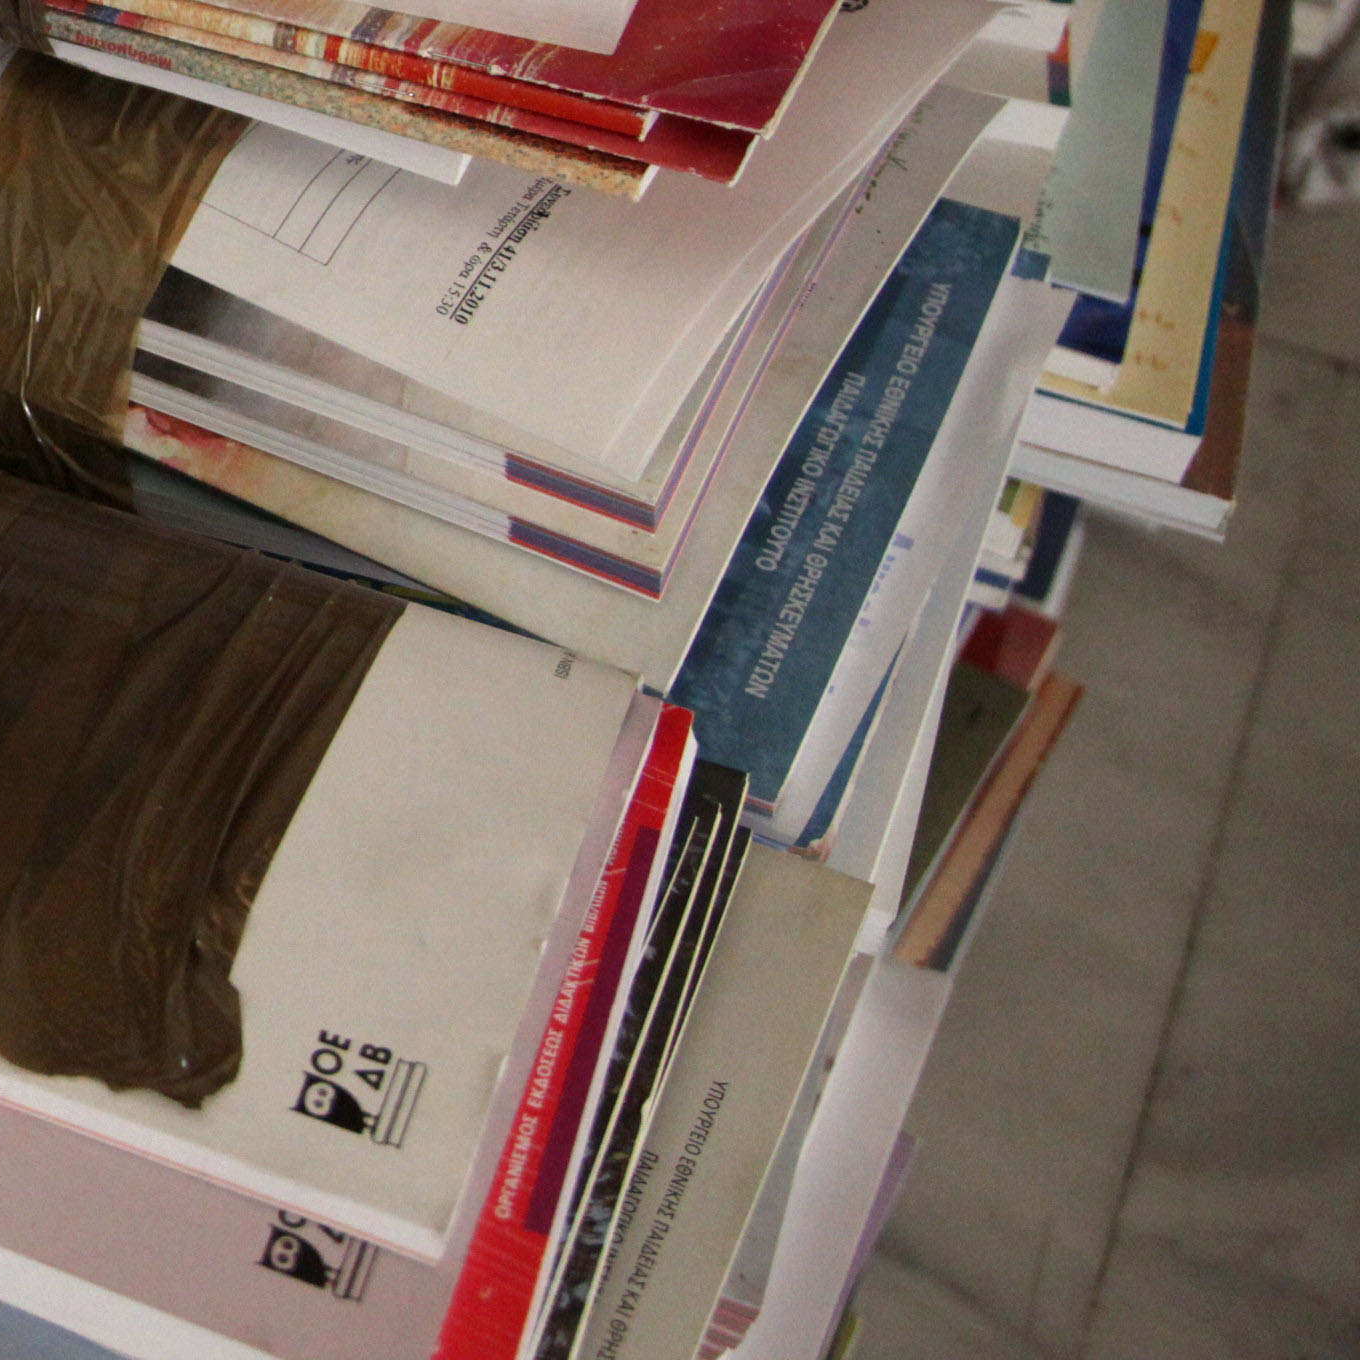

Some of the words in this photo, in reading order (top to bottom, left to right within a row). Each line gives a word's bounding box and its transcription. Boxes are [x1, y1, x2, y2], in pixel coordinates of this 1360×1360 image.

[433, 281, 467, 316] 15:30
[895, 281, 954, 377] ΥΠΟΥΡΓΕΙΟ
[798, 370, 867, 480] ΠΑΙΔΑΓΩΓΙΚΟ
[862, 377, 908, 450] ΕΘΝΙΚΗΣ
[827, 445, 878, 524] ΠΑΙΔΕΙΑΣ
[754, 479, 816, 575] ΙΝΣΤΙΤΟΥΤΟ
[814, 521, 845, 555] ΚΑΙ
[743, 552, 830, 702] ΘΡΗΣΚΕΥΜΑΤΩΝ
[494, 1113, 539, 1221] ΟΡΓΑΝΙΣΜΟΣ
[527, 1026, 566, 1110] ΕΚΔΟΣΕΩΣ
[554, 933, 594, 1028] ΔΙΔΑΚΤΙΚΩΝ
[683, 1078, 729, 1158] ΥΠΟΥΡΓΕΙΟ
[657, 1156, 699, 1222] ΕΘΝΙΚΗΣ
[628, 1219, 671, 1292] ΠΑΙΔΕΙΑΣ
